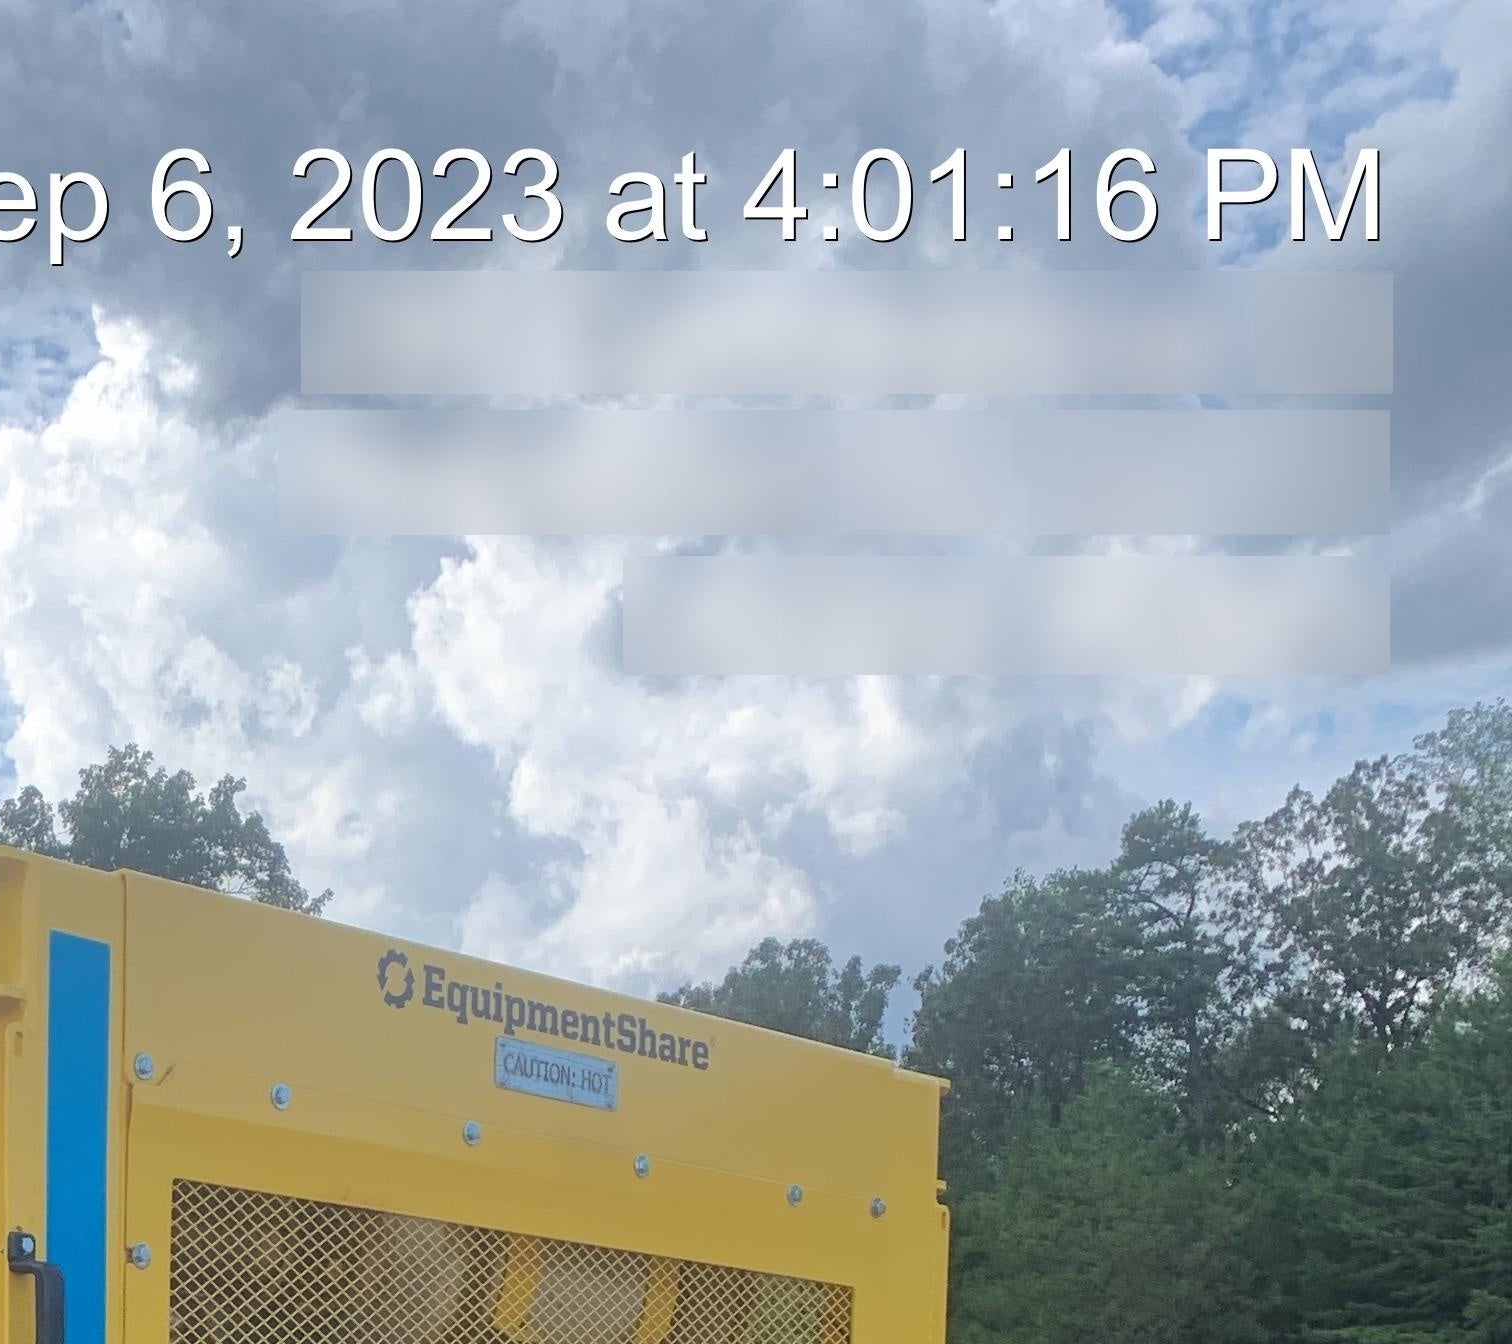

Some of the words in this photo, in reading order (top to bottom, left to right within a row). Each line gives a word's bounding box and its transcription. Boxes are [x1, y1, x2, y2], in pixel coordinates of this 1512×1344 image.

[422, 963, 710, 1071] EquipmentShare
[503, 1053, 577, 1090] CAUTION:
[581, 1069, 611, 1095] HOT
